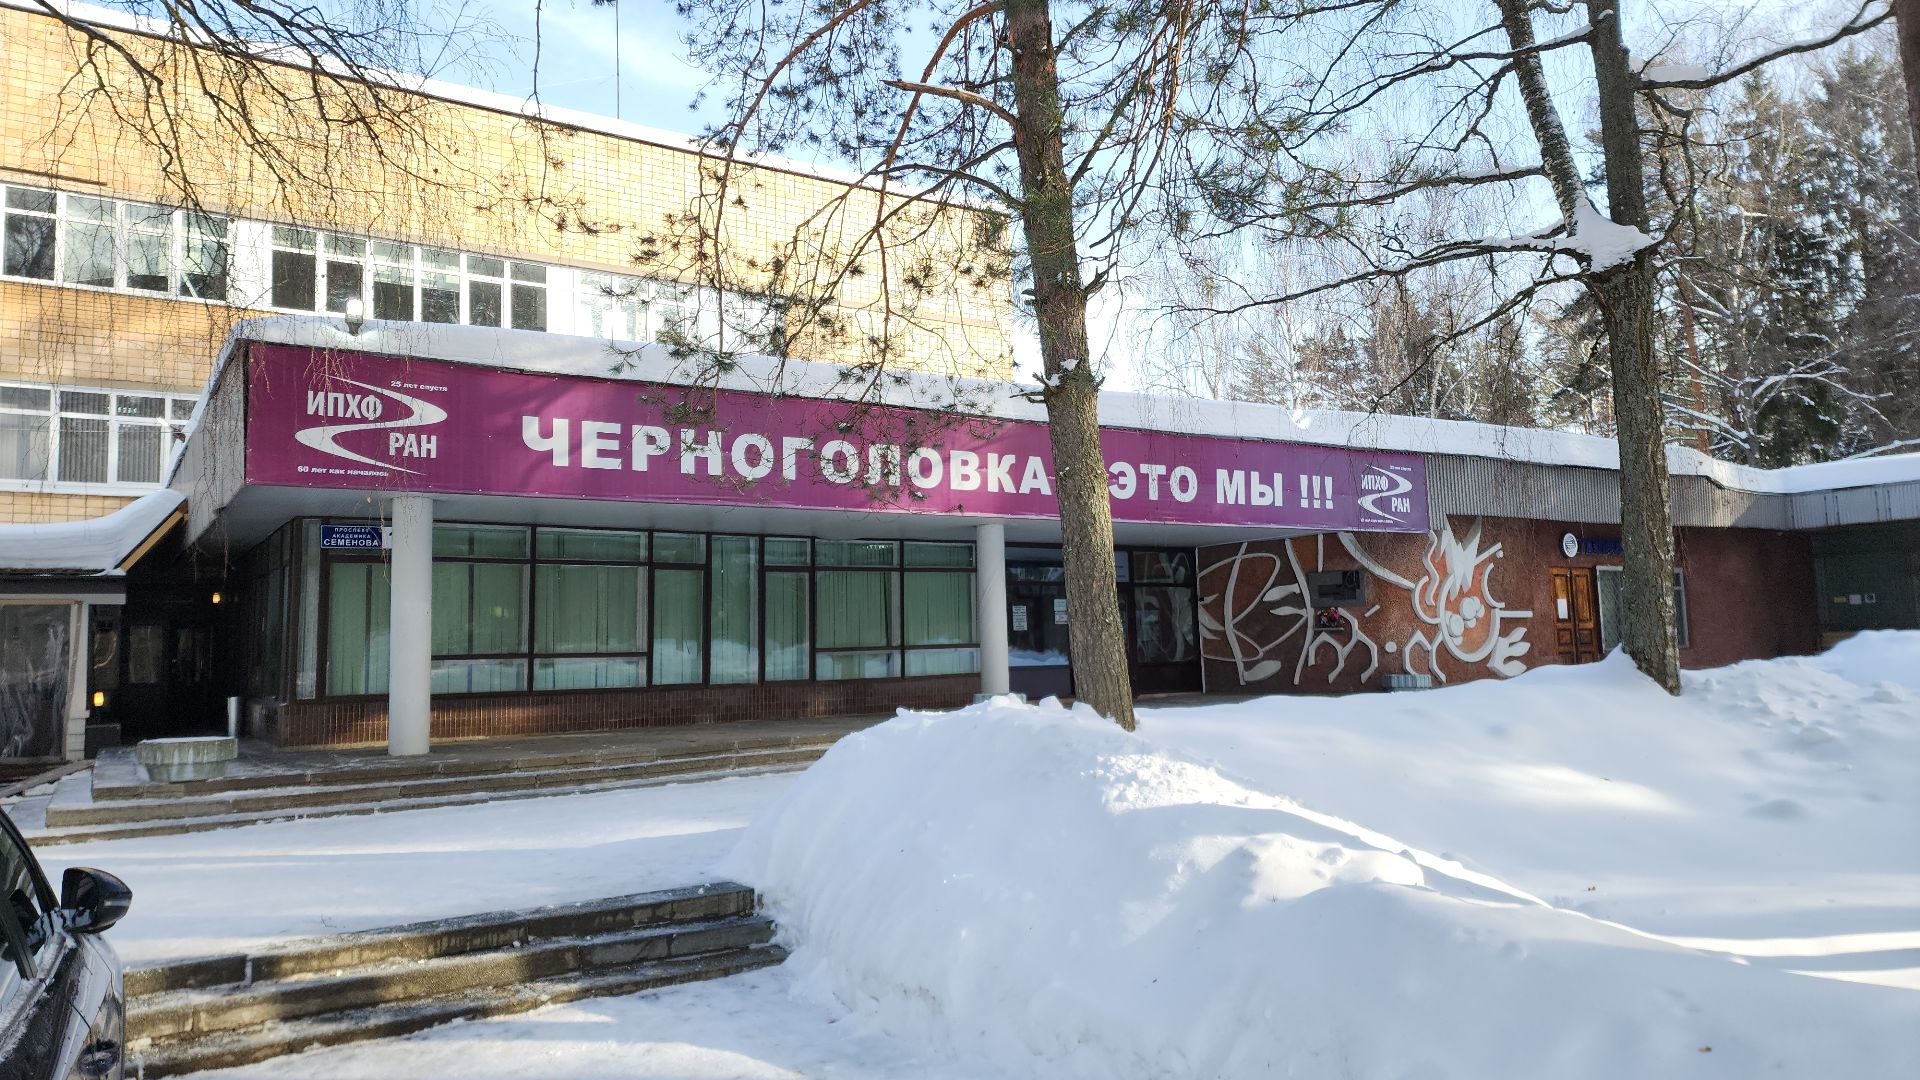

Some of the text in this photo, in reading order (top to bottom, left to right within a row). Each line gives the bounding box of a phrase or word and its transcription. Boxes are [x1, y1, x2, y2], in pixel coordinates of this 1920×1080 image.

[391, 380, 402, 388] 25
[420, 384, 448, 392] спустя
[306, 390, 383, 421] ИПХФ
[389, 432, 437, 459] РАН
[297, 465, 309, 473] 60
[522, 415, 1052, 496] ЧЕРНОГОЛОВКА
[1108, 461, 1198, 503] ЭТО
[1216, 468, 1283, 507] МЫ
[1361, 474, 1389, 492] ИПХФ
[1391, 497, 1411, 513] РАН
[323, 538, 379, 547] СЕМЕНОВА
